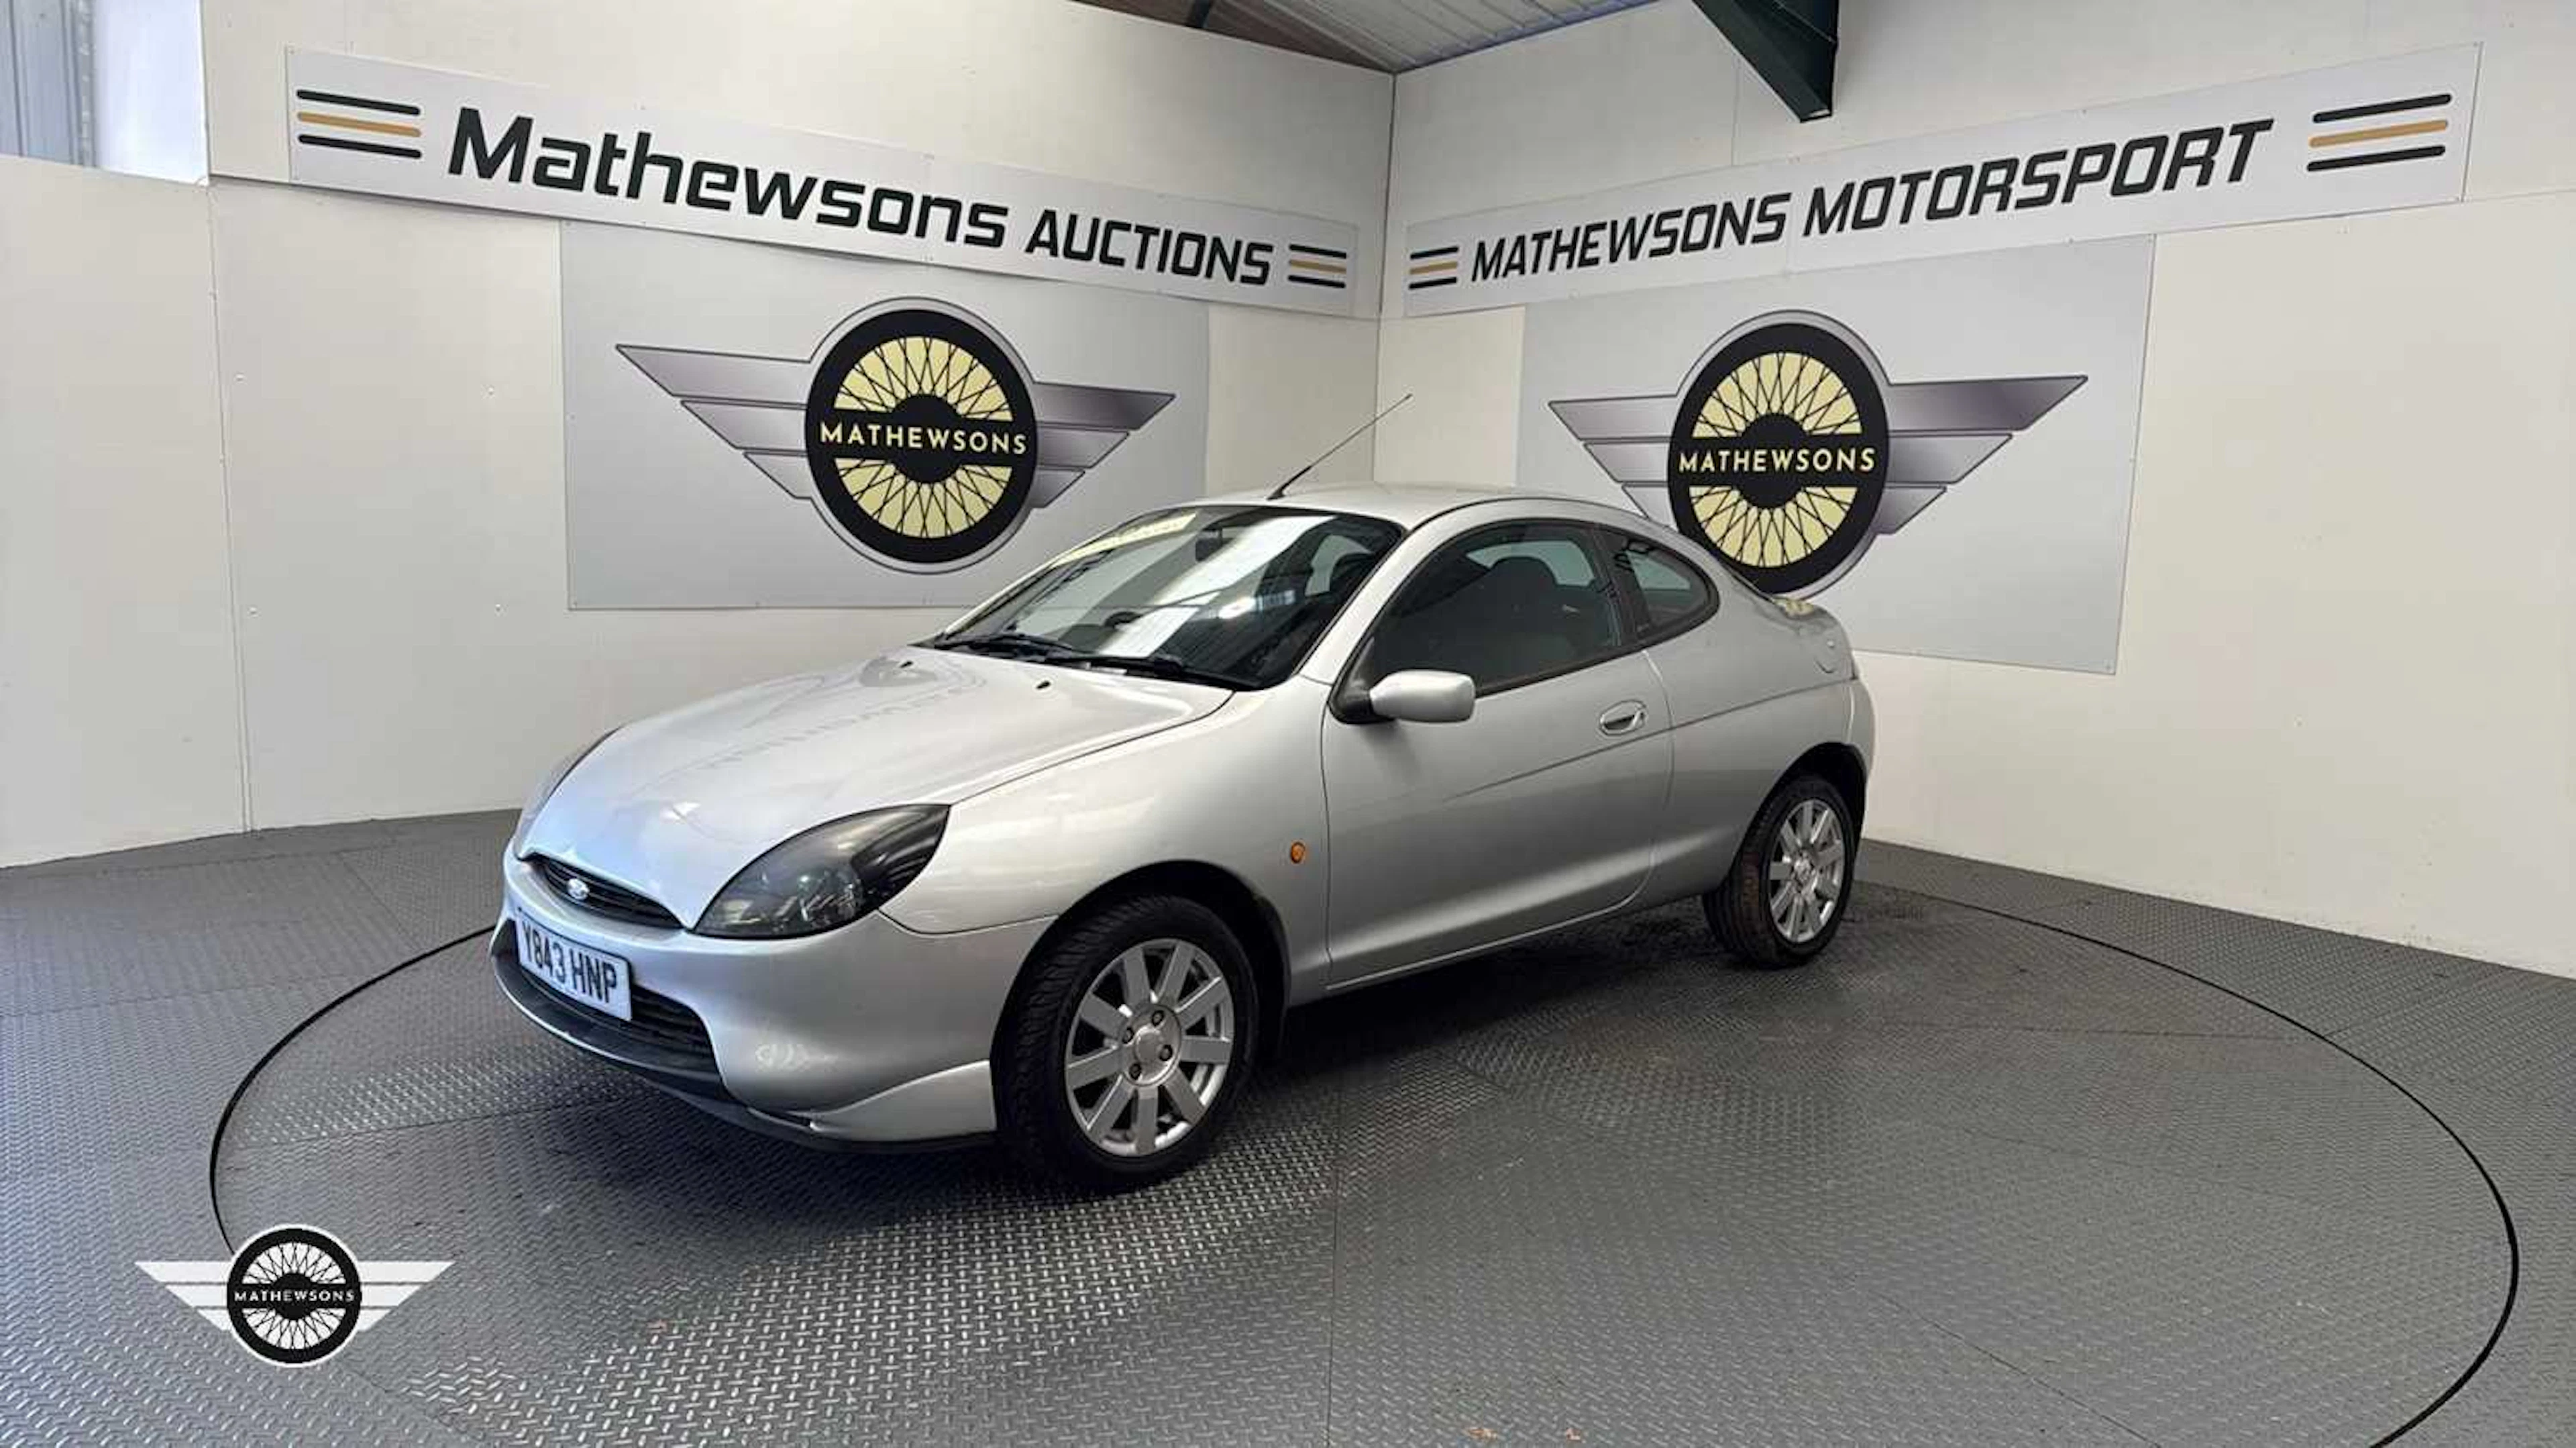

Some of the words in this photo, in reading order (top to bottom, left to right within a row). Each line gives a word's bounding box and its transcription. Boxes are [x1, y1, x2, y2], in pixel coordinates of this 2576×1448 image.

[448, 106, 1009, 248] Mathewsons
[1025, 209, 1274, 286] AUCTIONS
[1471, 191, 1792, 282] MATHEWSONS
[1803, 119, 2274, 236] MOTORSPORT
[820, 421, 1026, 455] MATHEWSONS
[1678, 447, 1876, 472] MATHEWSONS
[522, 920, 566, 984] Y843
[570, 948, 616, 1003] HNP
